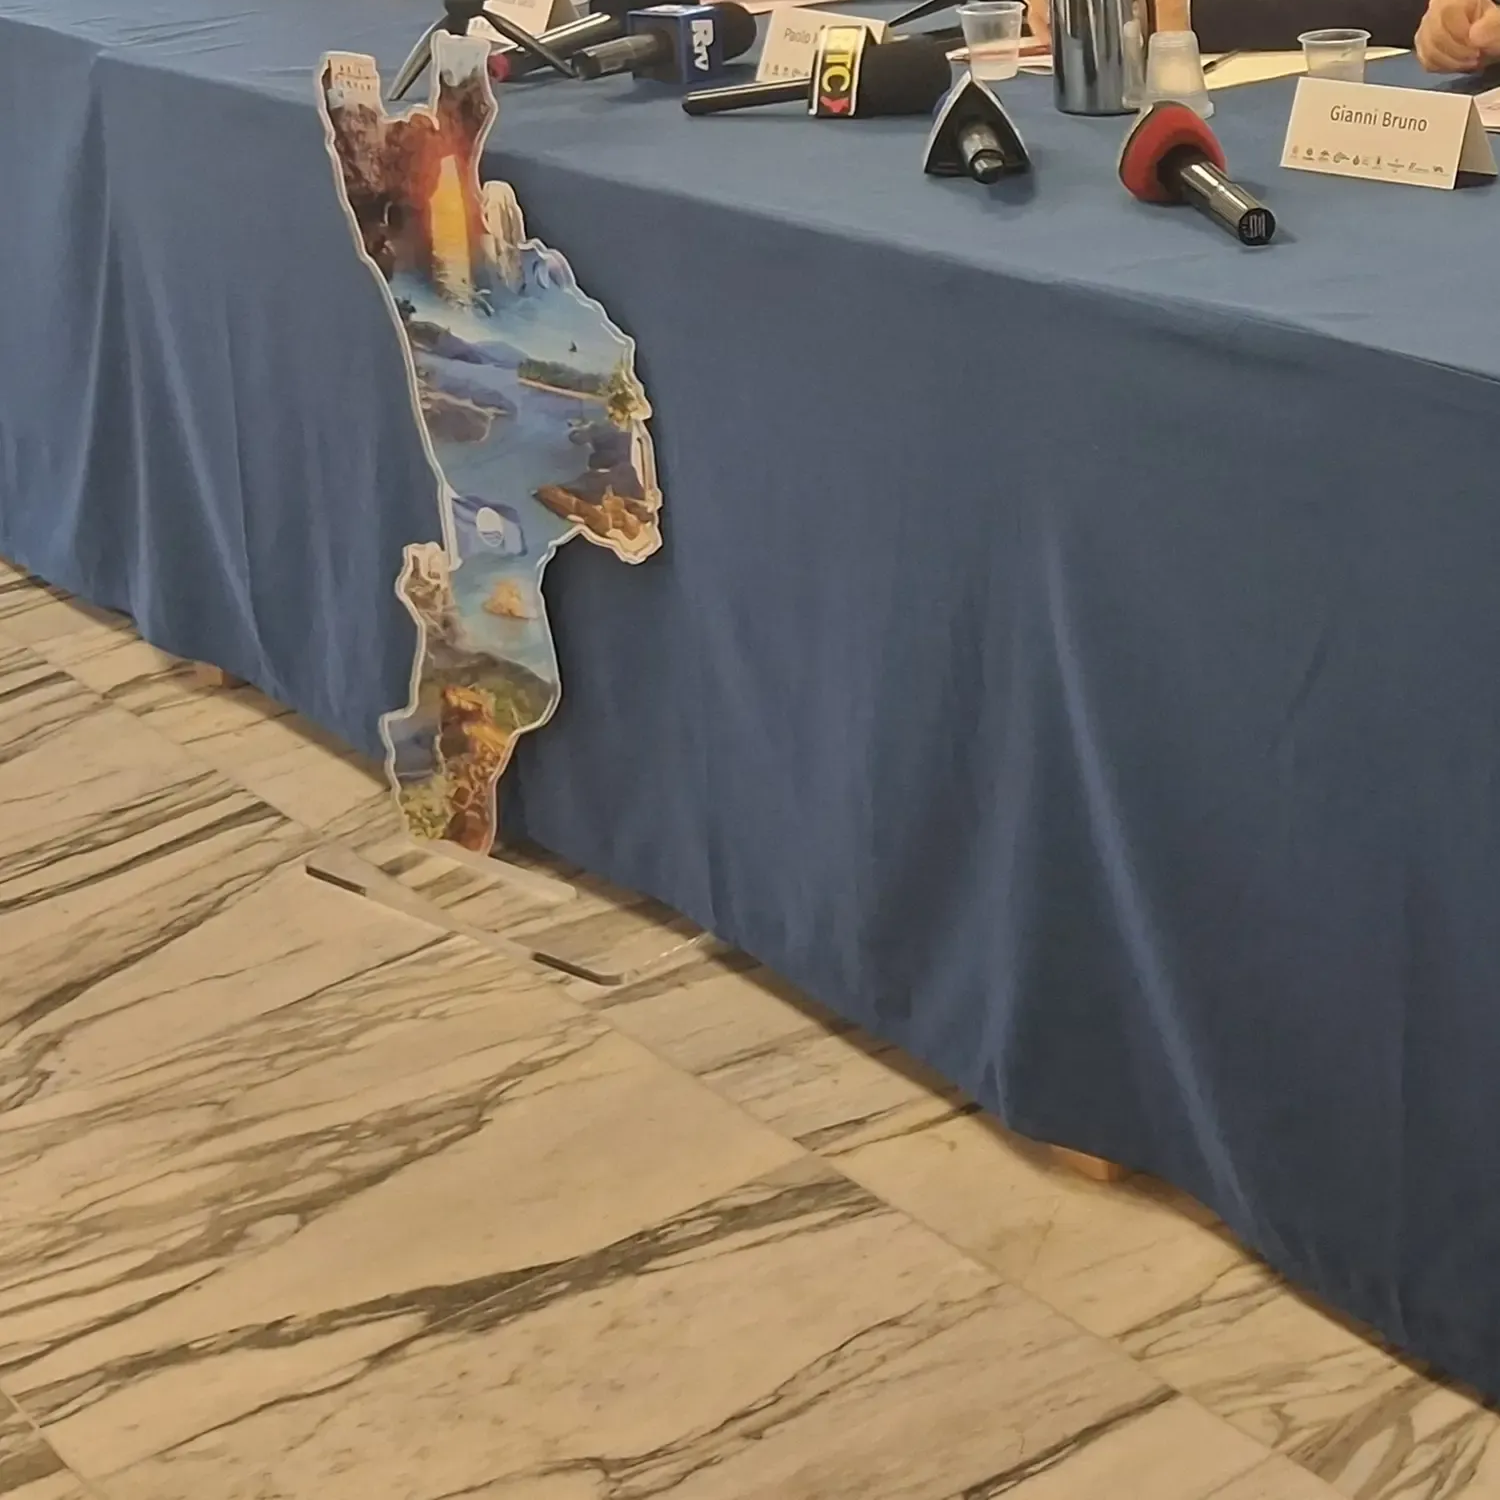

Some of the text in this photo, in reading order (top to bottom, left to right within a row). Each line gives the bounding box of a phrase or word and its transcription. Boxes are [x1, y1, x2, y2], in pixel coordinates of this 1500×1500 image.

[783, 27, 811, 43] Paolo
[1330, 104, 1428, 132] Gianni Bruno
